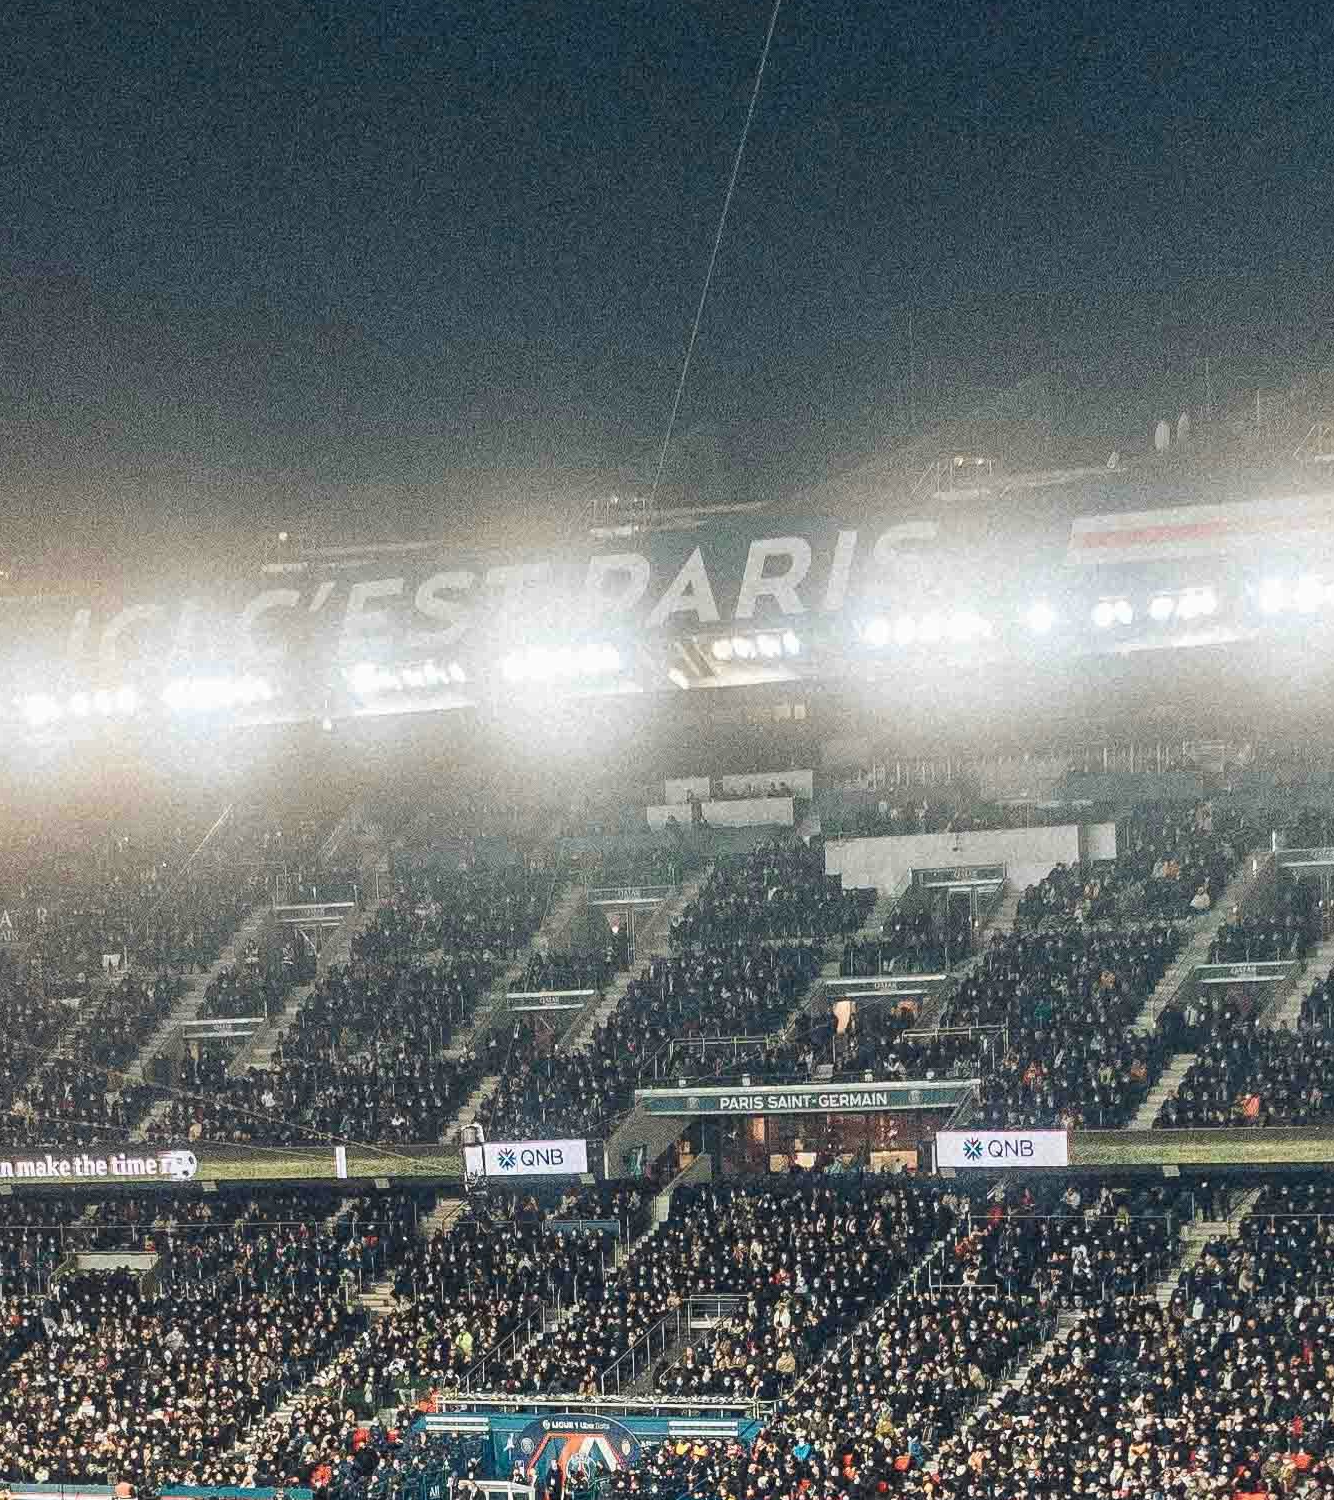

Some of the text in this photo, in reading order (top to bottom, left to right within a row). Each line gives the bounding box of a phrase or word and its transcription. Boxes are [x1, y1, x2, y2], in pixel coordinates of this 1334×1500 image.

[719, 1091, 888, 1110] PARIS SAINT-GERMAIN
[521, 1148, 565, 1167] QNB
[987, 1138, 1034, 1159] QNB
[18, 1154, 70, 1178] make
[73, 1153, 108, 1177] the
[112, 1152, 157, 1176] time
